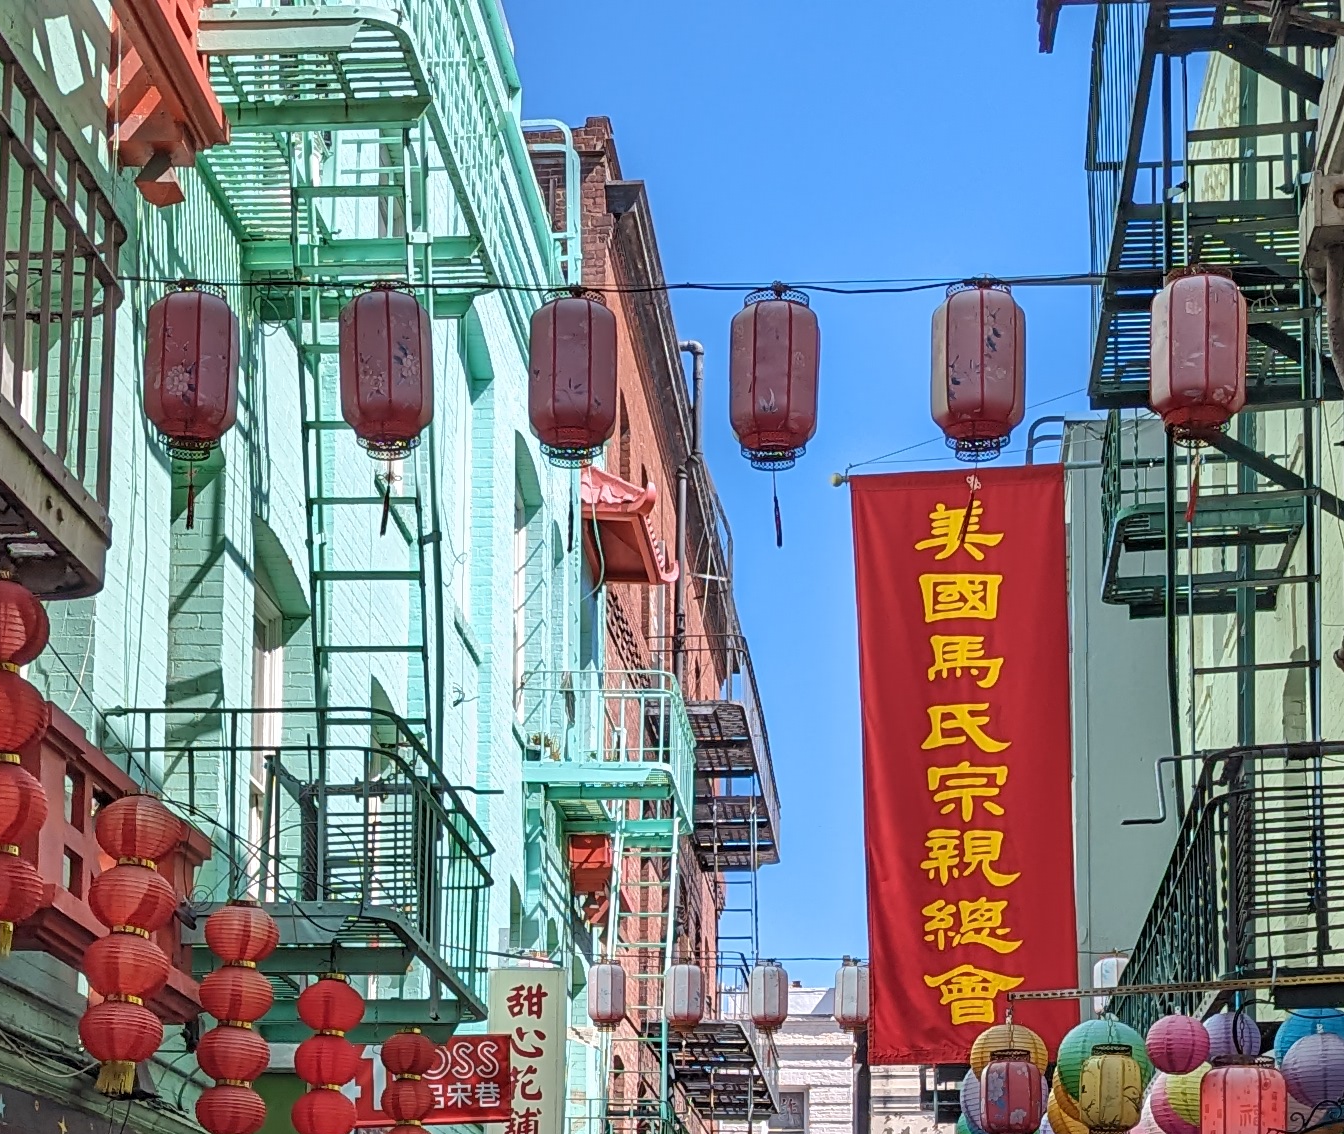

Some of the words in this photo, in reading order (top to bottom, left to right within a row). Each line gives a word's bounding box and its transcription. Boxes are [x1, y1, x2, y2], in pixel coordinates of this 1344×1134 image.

[914, 501, 1025, 1025] 美國馬氏宗親總會
[422, 1041, 500, 1080] OSS
